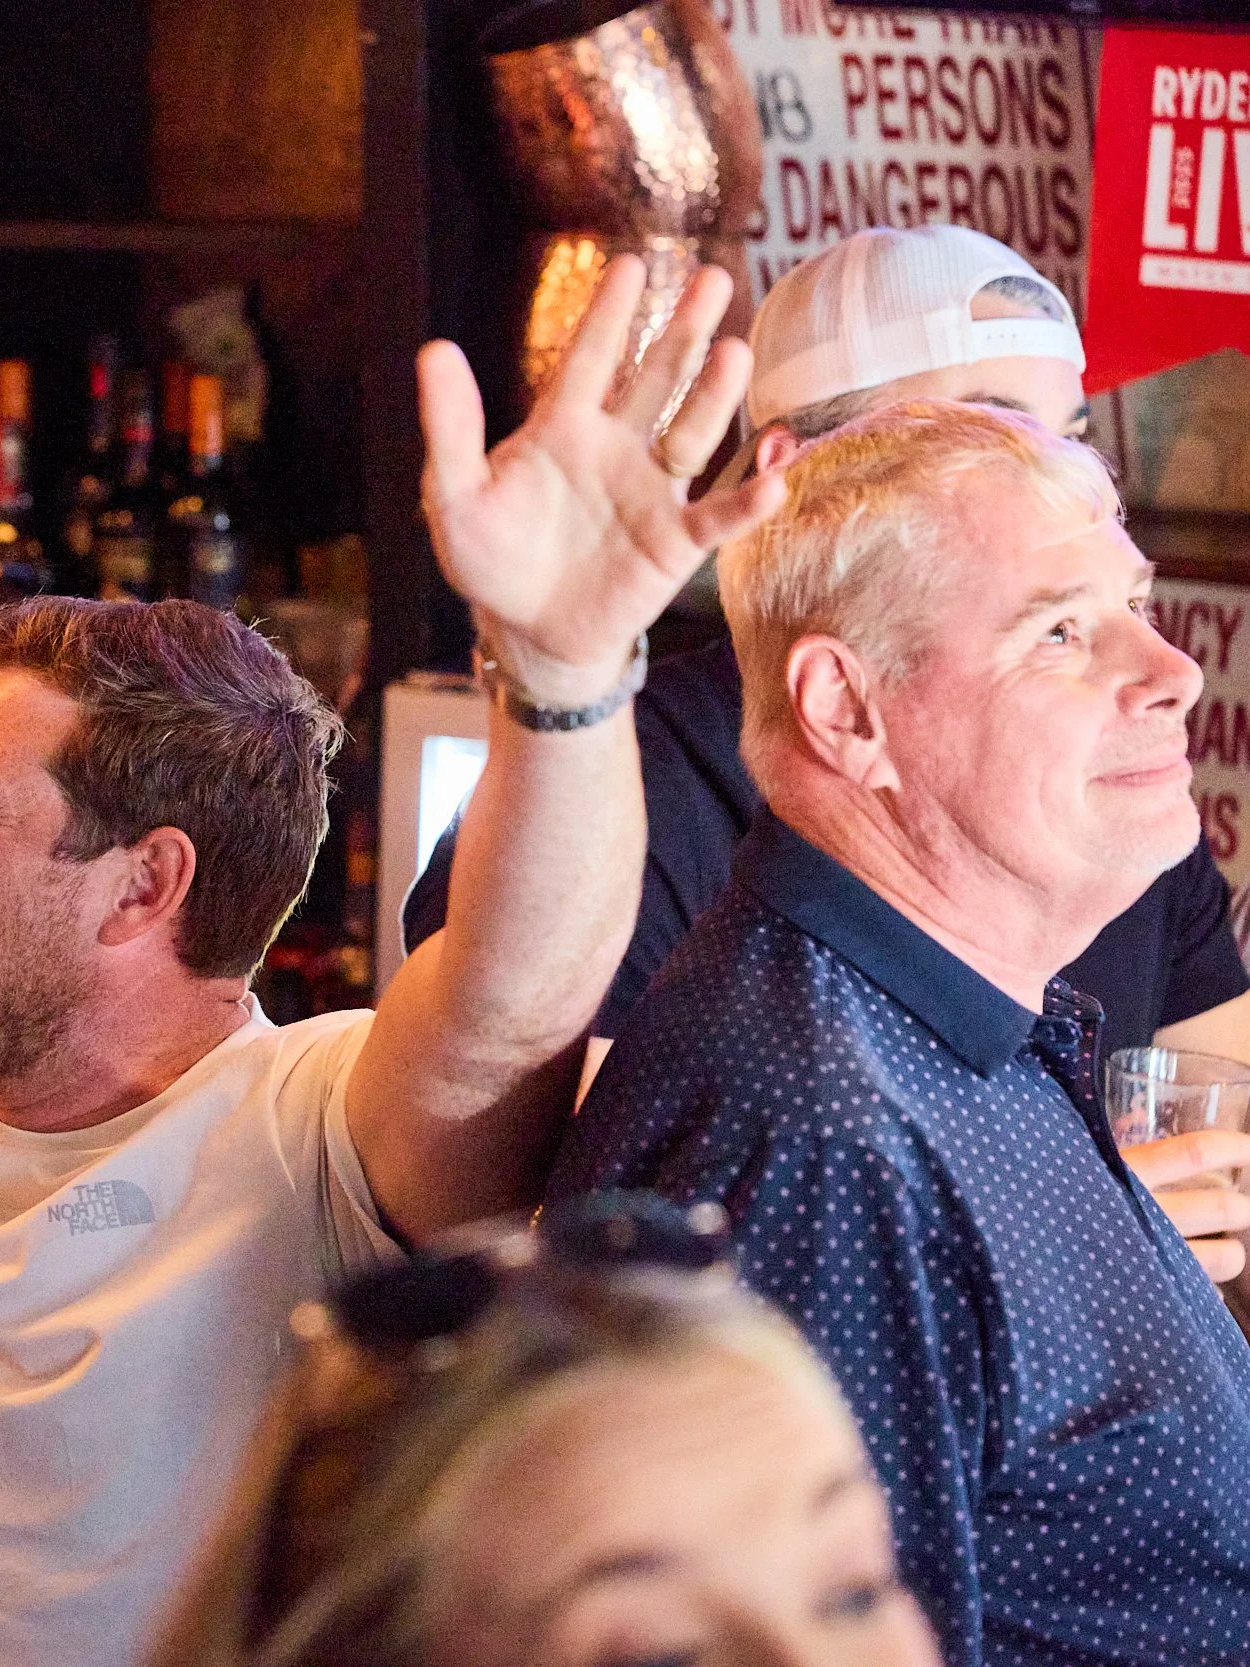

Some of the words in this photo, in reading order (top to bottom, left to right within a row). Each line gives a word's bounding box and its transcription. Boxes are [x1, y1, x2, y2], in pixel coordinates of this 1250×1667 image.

[839, 52, 1072, 147] PERSONS
[1151, 64, 1250, 123] RYDE
[779, 157, 1082, 258] DANGEROUS
[47, 1198, 117, 1223] NORTH
[73, 1180, 113, 1204] THE
[68, 1212, 120, 1237] FACE
